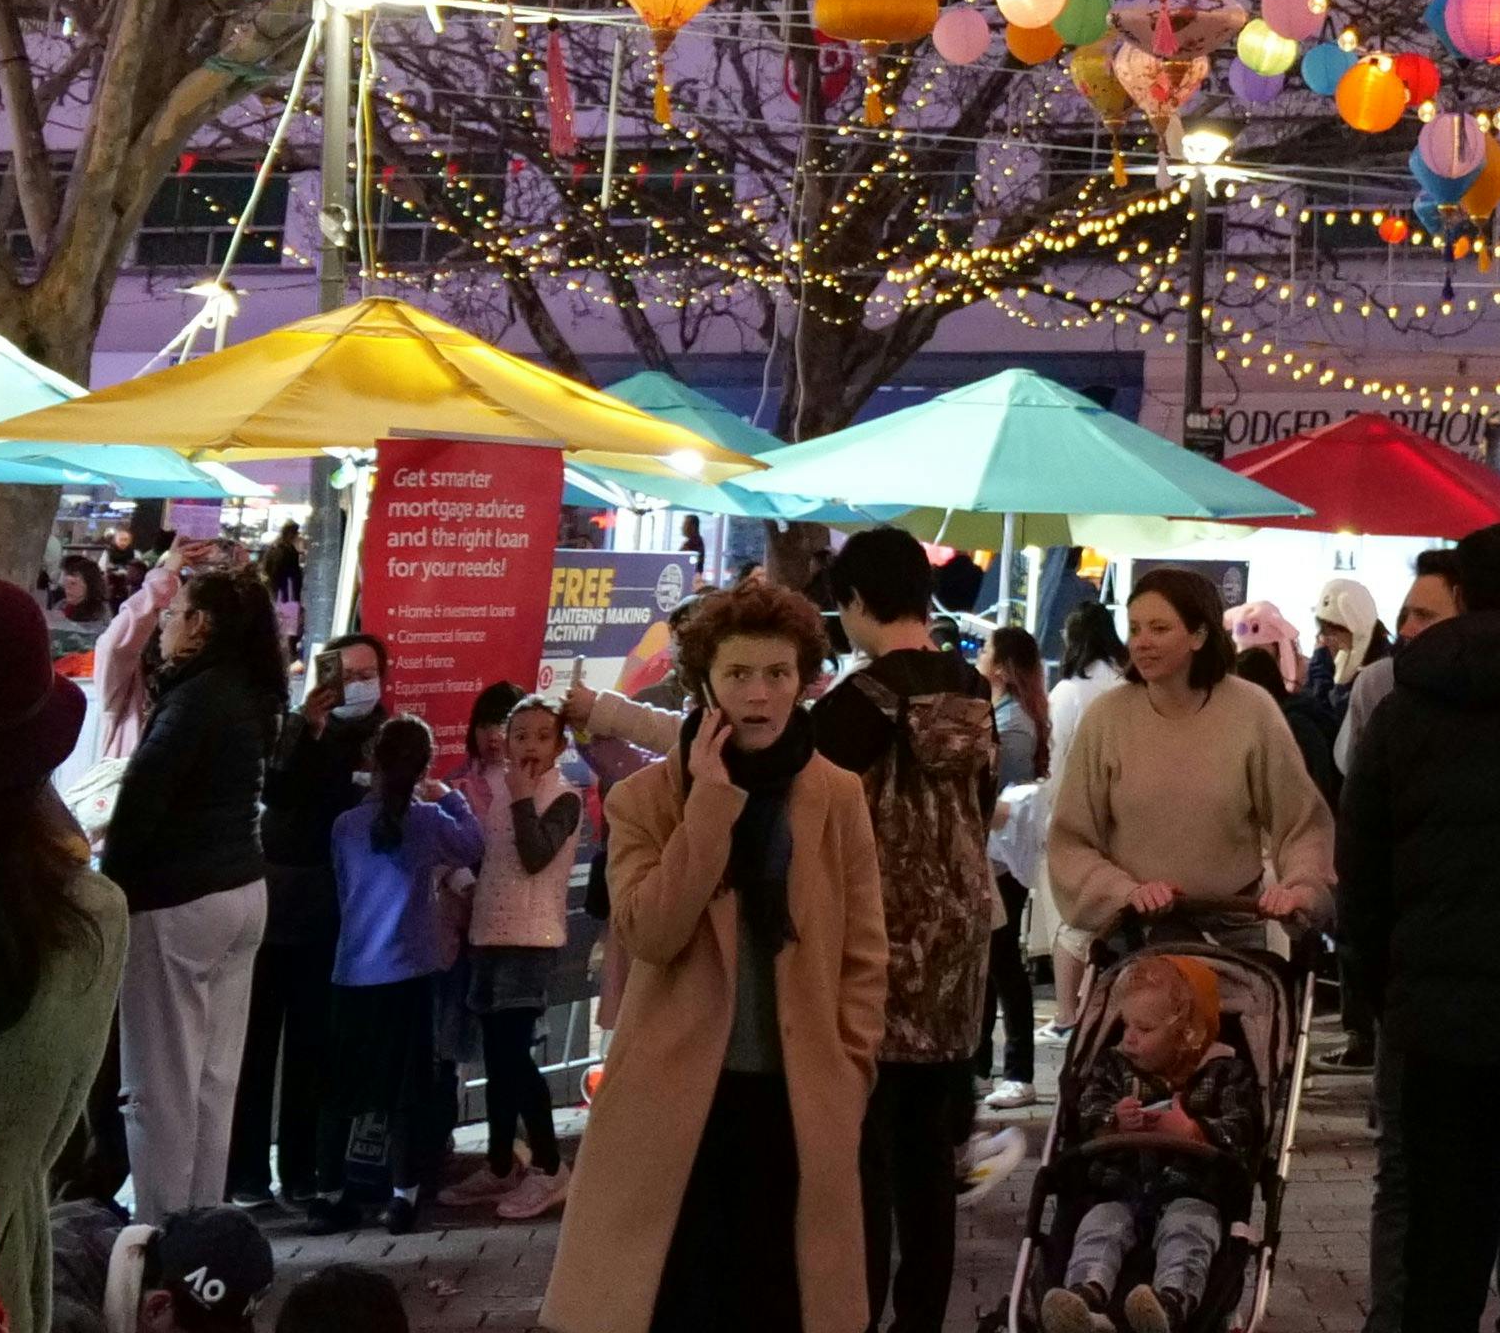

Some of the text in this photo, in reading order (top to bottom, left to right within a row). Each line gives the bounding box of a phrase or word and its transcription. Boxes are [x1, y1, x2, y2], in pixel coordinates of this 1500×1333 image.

[393, 467, 493, 489] Get smarter
[387, 498, 526, 523] mortgage advice
[386, 526, 530, 553] and the right loan
[387, 556, 507, 583] for your needs!
[550, 567, 616, 609] FREE
[398, 604, 432, 619] Home
[546, 607, 651, 625] LANTERNS MAKING
[544, 624, 597, 642] ACTIVITY
